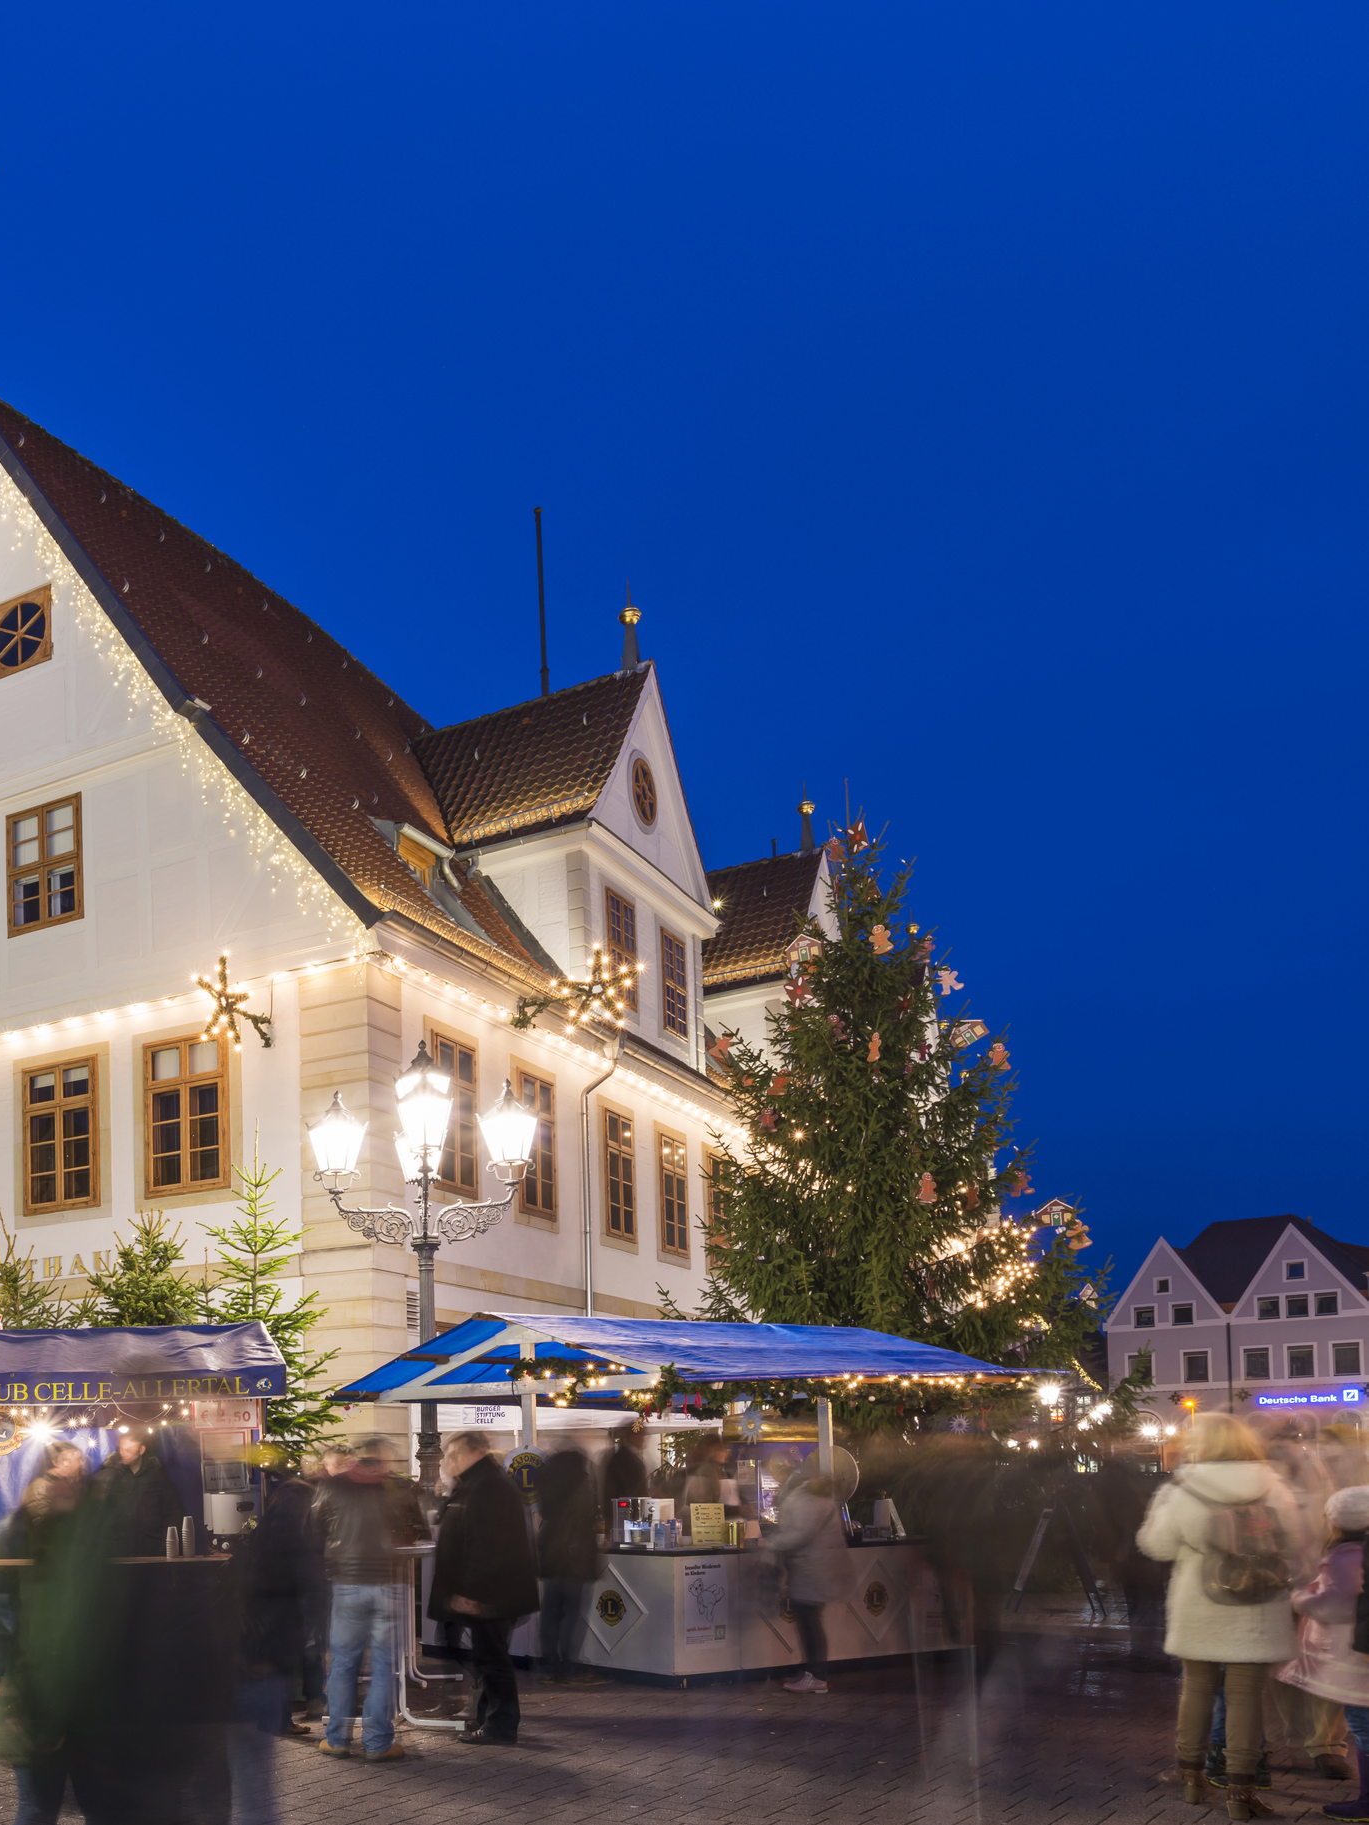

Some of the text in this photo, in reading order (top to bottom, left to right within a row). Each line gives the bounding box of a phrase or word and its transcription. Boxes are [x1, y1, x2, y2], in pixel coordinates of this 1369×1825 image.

[34, 1376, 250, 1402] CELLE-ALLERTAL
[1259, 1394, 1338, 1405] Deutsche Bank
[200, 1409, 209, 1422] €
[515, 1454, 541, 1467] LIONS
[520, 1468, 535, 1488] L
[606, 1600, 616, 1615] L
